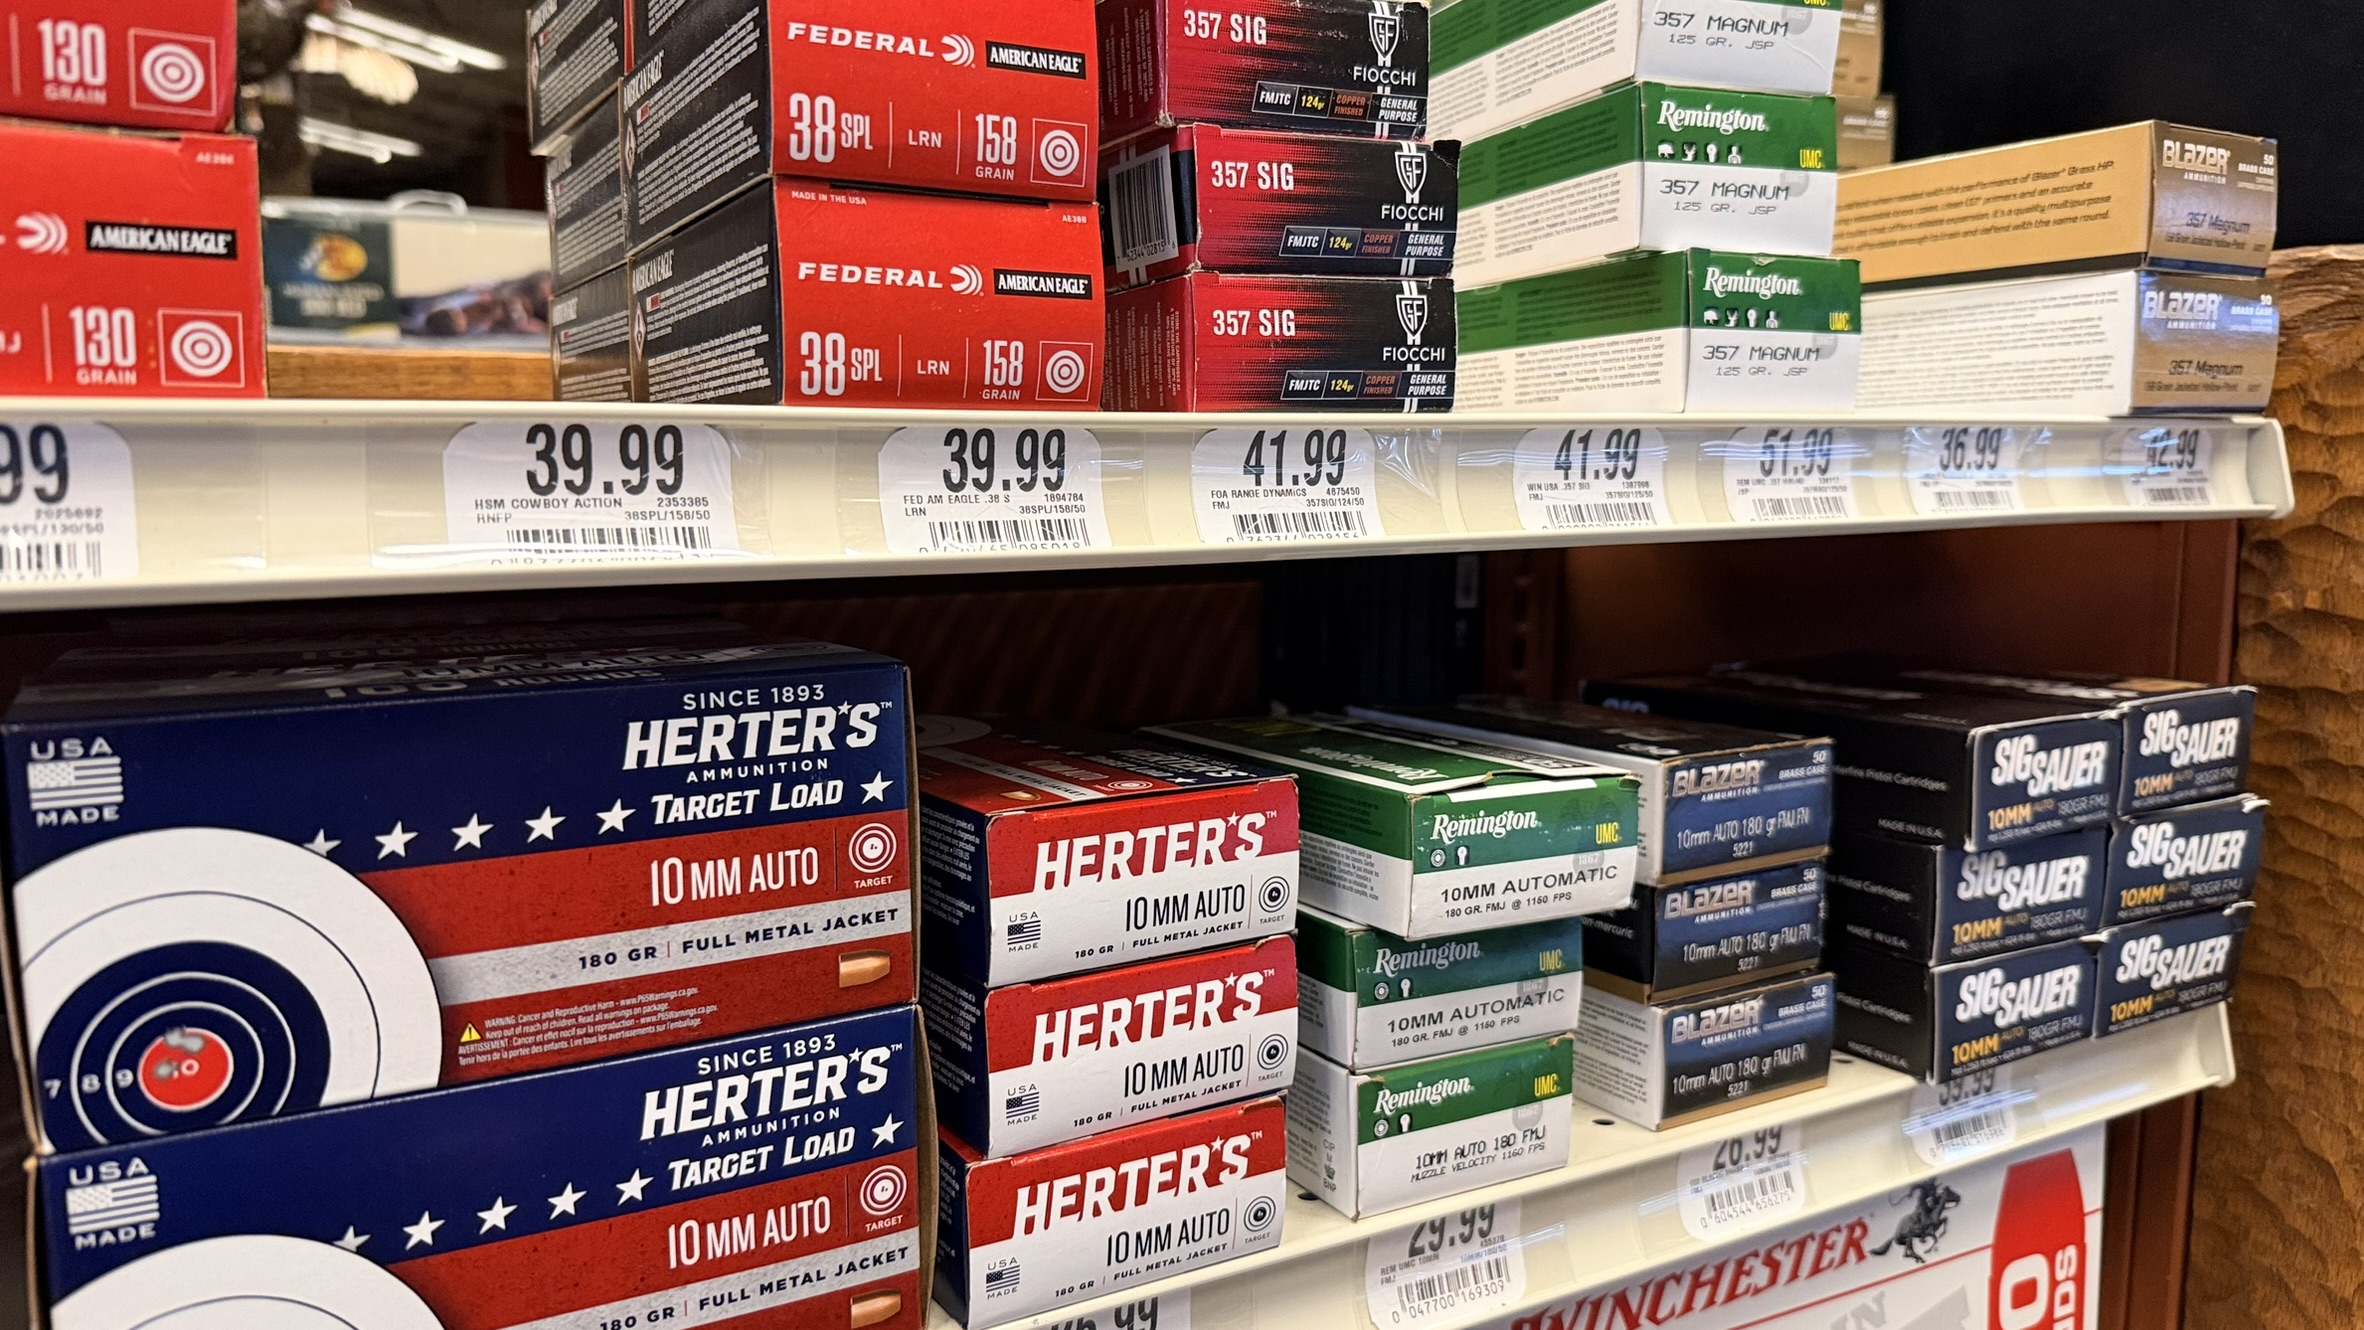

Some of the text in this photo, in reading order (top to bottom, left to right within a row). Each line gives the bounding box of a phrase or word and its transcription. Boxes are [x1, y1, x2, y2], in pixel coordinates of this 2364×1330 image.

[1183, 10, 1267, 45] 357 SIG
[1653, 11, 1789, 37] 357 MAGNUM
[37, 18, 107, 86] 130
[787, 22, 935, 58] FEDERAL
[1668, 34, 1696, 45] 125
[1745, 38, 1774, 50] JSP
[990, 47, 1082, 74] AMERICAN EAGLE
[1353, 66, 1417, 86] FIOCCHI
[789, 93, 836, 163] 38
[841, 112, 874, 151] SPL
[1657, 99, 1769, 135] Remington
[908, 129, 942, 148] LRN
[975, 113, 1017, 166] 158
[975, 166, 1015, 181] GRAIN
[1211, 160, 1294, 191] 357 SIG
[792, 190, 868, 206] MADE IN THE USA
[1660, 180, 1790, 200] 357 MAGNUM
[1381, 205, 1443, 222] FIOCCHI
[1674, 201, 1701, 212] 125
[1749, 204, 1776, 215] JSP
[90, 225, 232, 255] AMERICAN EAGLE
[1288, 234, 1320, 250] FMJTC
[1361, 244, 1391, 255] FINISHED
[1363, 233, 1393, 245] COPPER
[1405, 245, 1443, 257] PURPOSE
[1407, 233, 1445, 246] GENERAL
[798, 262, 943, 288] FEDERAL
[1703, 265, 1803, 300] Remington
[1212, 309, 1296, 337] 357 SIG
[69, 306, 137, 367] 130
[800, 331, 845, 396] 38
[851, 347, 882, 383] SPL
[983, 340, 1023, 387] 158
[1382, 347, 1446, 363] FIOCCHI
[1703, 346, 1820, 362] 357 MAGNUM
[917, 359, 950, 376] LRN
[1409, 373, 1447, 386] GENERAL
[1408, 385, 1447, 397] PURPOSE
[526, 424, 684, 496] 39.99
[943, 428, 1066, 493] 39.99
[1243, 429, 1347, 487] 41.99
[1554, 428, 1641, 481] 41.99
[1760, 428, 1834, 477] 51.99
[1939, 427, 2003, 471] 36.99
[904, 495, 924, 505] FED
[927, 494, 943, 504] AM
[948, 494, 981, 504] EAGLE
[1044, 493, 1083, 502] 1894784
[1231, 488, 1307, 498] RANGE DYNAMICS
[1326, 487, 1360, 496] 4875450
[1527, 483, 1558, 491] WIN USA
[475, 497, 623, 510] HSM COWBOY ACTION
[657, 497, 709, 507] 2353385
[905, 507, 926, 517] LRN
[1019, 504, 1086, 514] 38SPL/158/50
[1212, 500, 1230, 510] FMJ
[683, 684, 825, 711] SINCE 1893
[30, 737, 113, 760] USA
[687, 758, 829, 784] AMMUNITION
[1991, 734, 2108, 797] SIG SAUER
[651, 779, 844, 825] TARGET LOAD
[1701, 786, 1758, 802] AMMUNITION
[36, 805, 119, 827] MADE
[1430, 810, 1541, 844] Remington
[1988, 804, 2032, 831] 10MM
[1712, 824, 1739, 841] AUTO
[1742, 818, 1763, 836] 180
[2126, 821, 2175, 869] SIG
[2163, 829, 2249, 881] SAUER
[651, 847, 819, 907] 10 MM AUTO
[1440, 866, 1618, 904] 10MM AUTOMATIC
[1009, 910, 1039, 922] USA
[1126, 884, 1246, 931] 10 MM AUTO
[1445, 906, 1462, 918] 180
[1485, 901, 1505, 913] FMJ
[1553, 892, 1572, 903] FPS
[579, 908, 899, 970] 180 GR FULL METAL JACKET
[1008, 942, 1039, 953] MADE
[1075, 921, 1244, 959] 180 GR FULL METAL JACKET
[1372, 940, 1481, 977] Remington
[1955, 964, 2083, 1029] SIG SAUER
[1388, 988, 1565, 1034] 10MM AUTOMATIC
[1373, 1076, 1473, 1115] Remington
[1454, 1141, 1486, 1162] AUTO
[1494, 1134, 1516, 1151] 180
[1522, 1125, 1546, 1145] FMJ
[1409, 1279, 1505, 1319] 047700 169309
